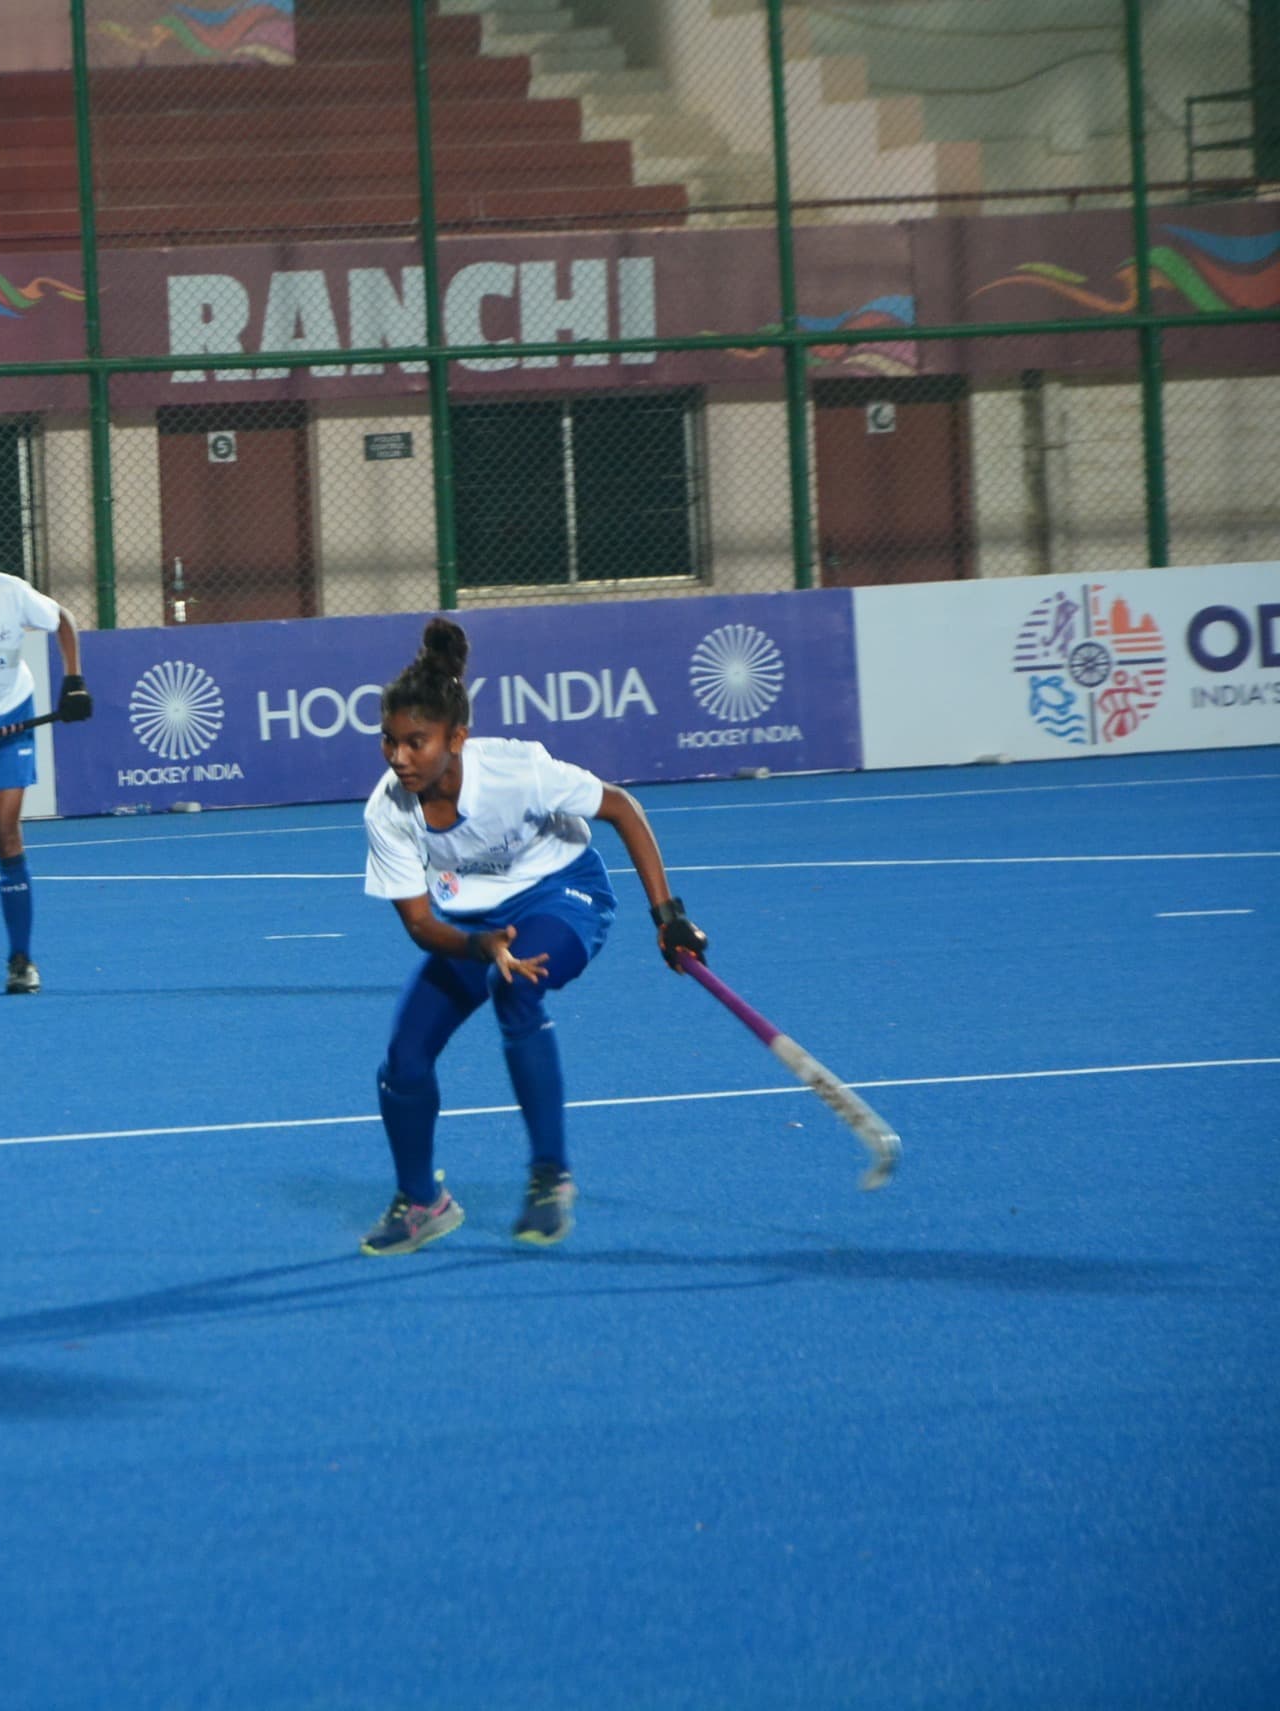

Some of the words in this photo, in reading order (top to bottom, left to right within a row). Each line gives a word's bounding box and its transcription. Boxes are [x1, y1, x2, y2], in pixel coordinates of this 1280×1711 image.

[166, 257, 657, 384] RANCHI
[257, 677, 488, 741] HOCY
[499, 667, 658, 725] INDIA
[677, 728, 751, 749] HOCKEY
[753, 725, 804, 744] INDIA
[118, 766, 190, 787] HOCKEY
[193, 763, 244, 782] INDIA
